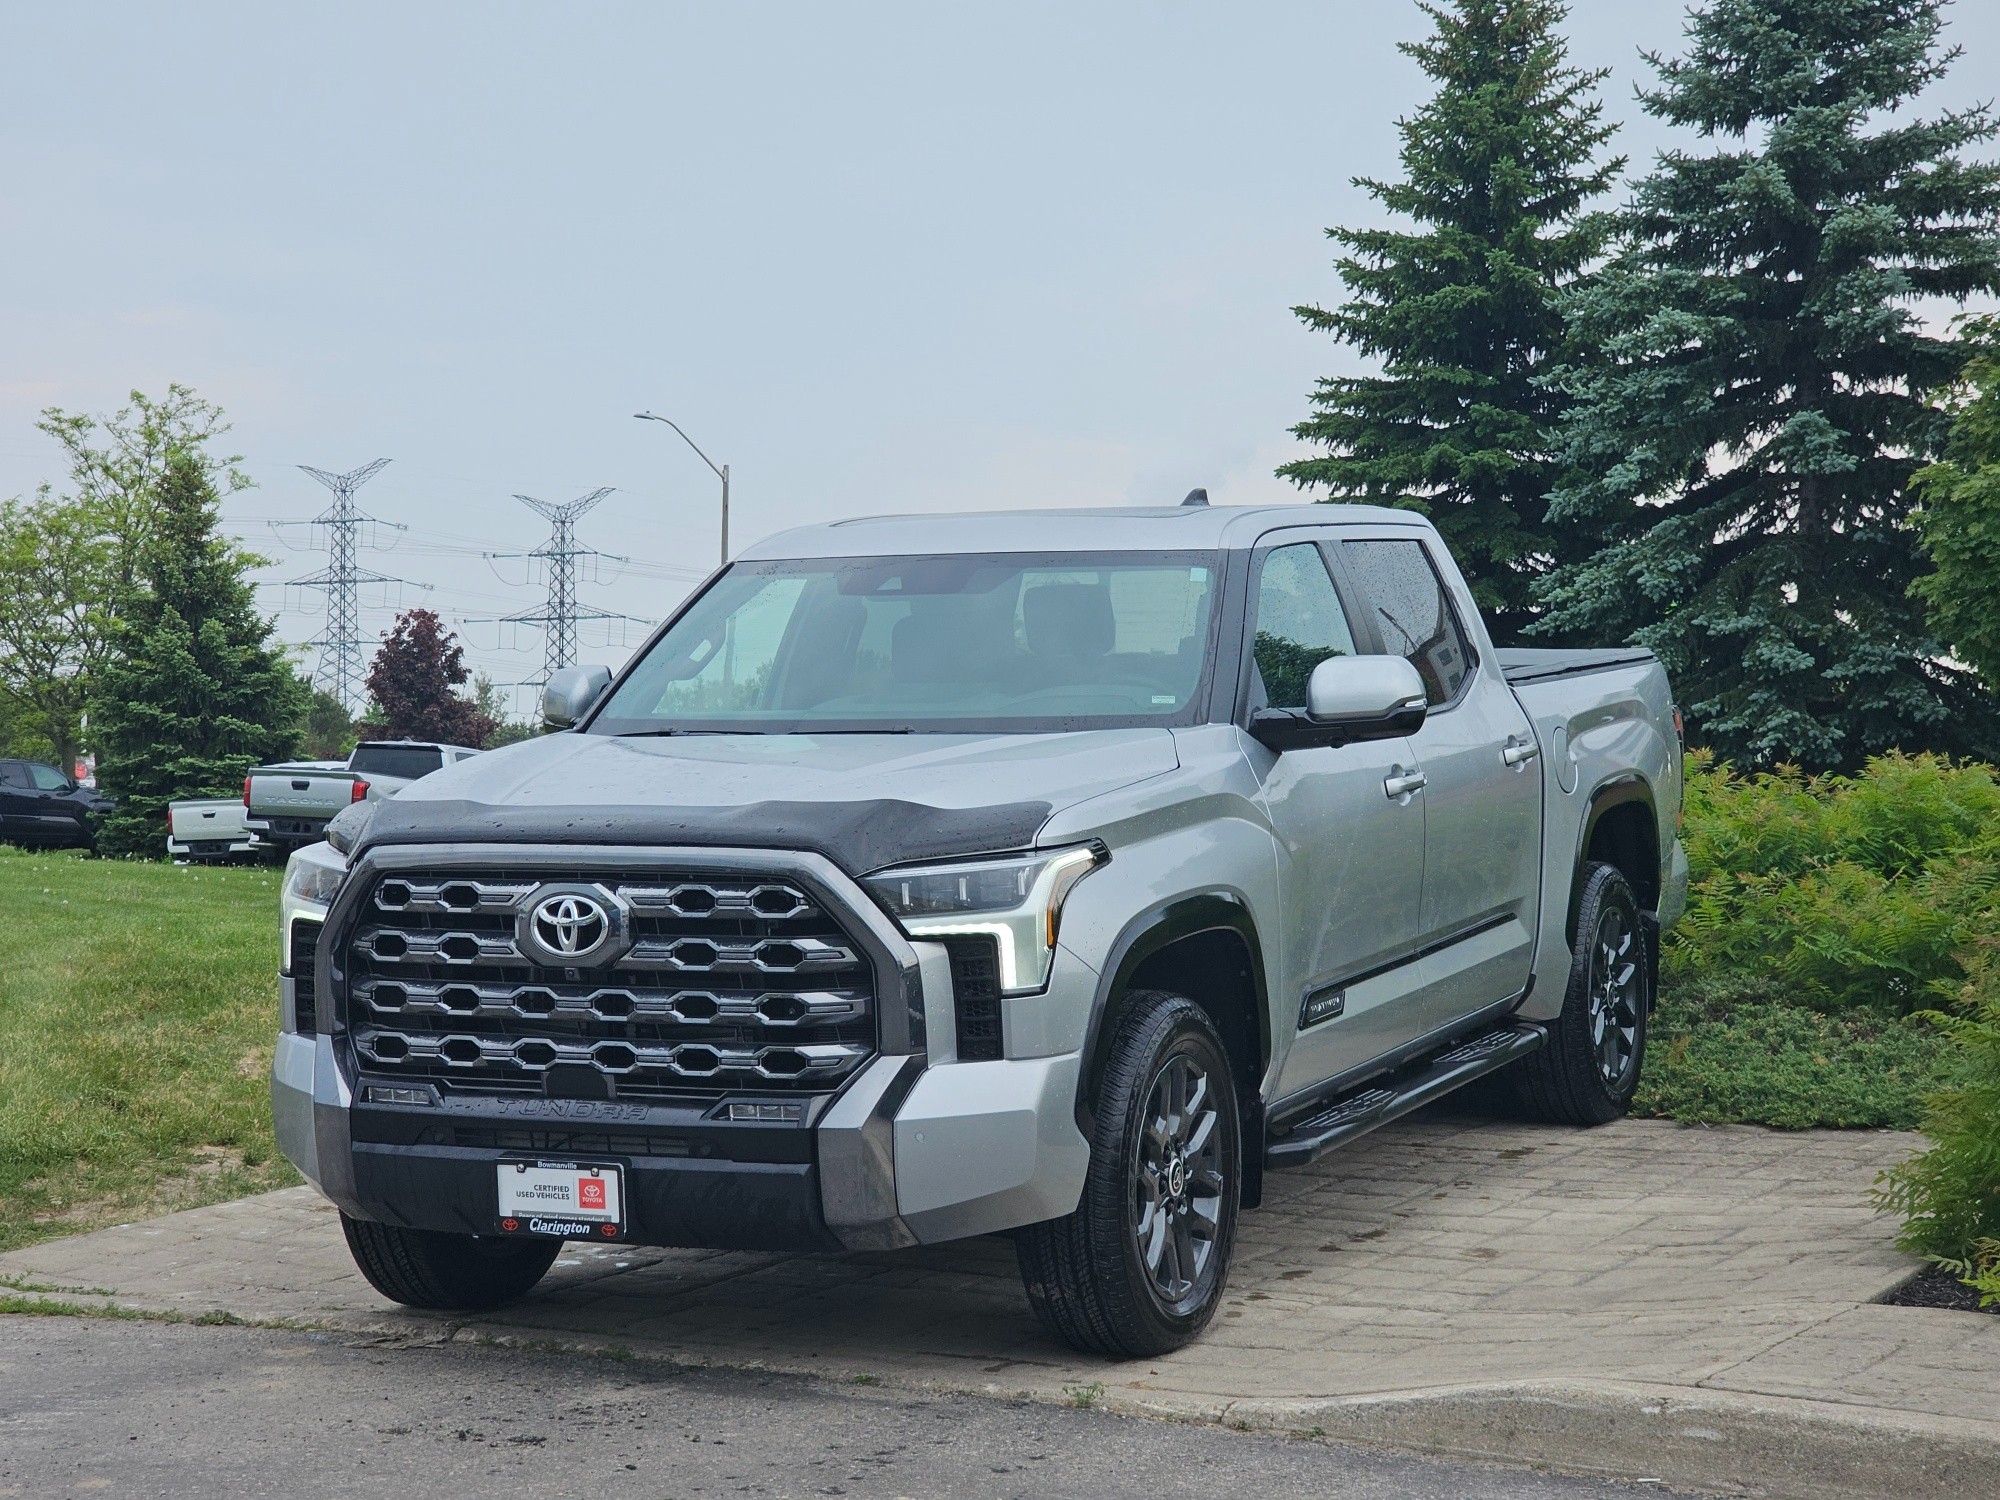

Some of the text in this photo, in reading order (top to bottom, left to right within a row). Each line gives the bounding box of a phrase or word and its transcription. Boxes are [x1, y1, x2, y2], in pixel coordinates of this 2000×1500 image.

[265, 796, 336, 807] TACOMA
[497, 1099, 650, 1120] TUNDRA
[537, 1161, 577, 1170] Bowmanville
[533, 1184, 570, 1193] CERTIFIED
[516, 1190, 570, 1200] USED VEHICLES
[529, 1218, 591, 1235] Clarington
